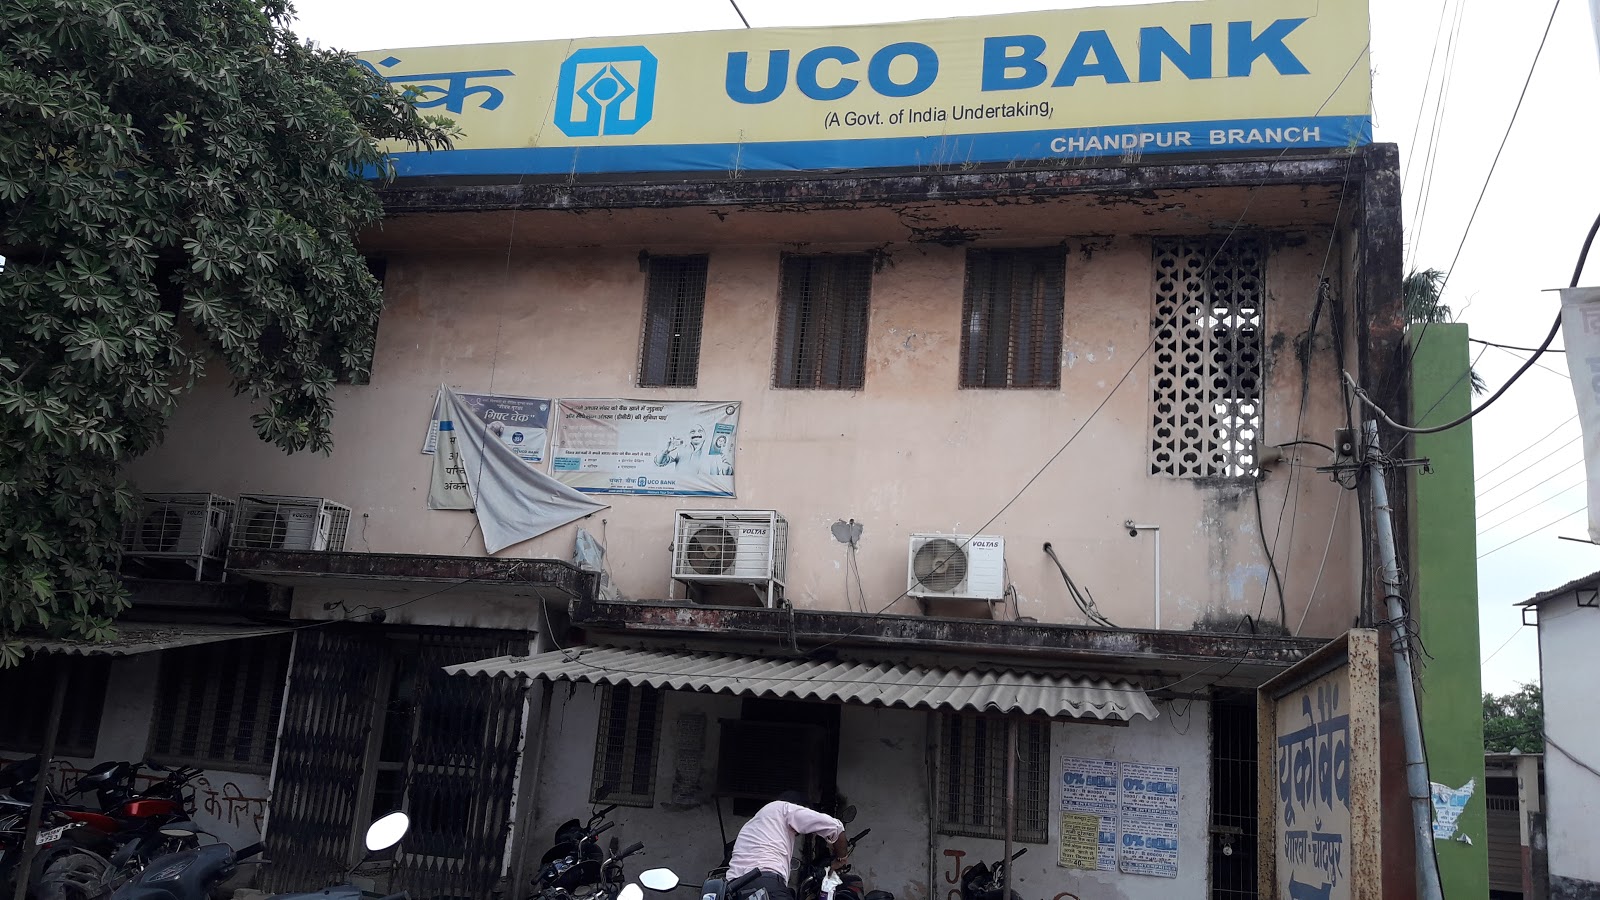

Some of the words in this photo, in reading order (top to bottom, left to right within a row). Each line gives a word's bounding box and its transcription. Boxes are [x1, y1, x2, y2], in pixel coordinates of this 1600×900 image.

[725, 42, 939, 104] UCO
[981, 17, 1311, 92] BANK
[824, 111, 840, 129] (A
[844, 110, 884, 126] Govt.
[889, 109, 904, 124] of
[908, 106, 947, 122] India
[1050, 130, 1193, 153] CHANDPUR
[1209, 126, 1321, 146] BRANCH
[972, 540, 1000, 548] VOLTAS
[1064, 772, 1085, 785] 0%
[1123, 778, 1145, 791] 0%
[1122, 834, 1145, 847] 0%
